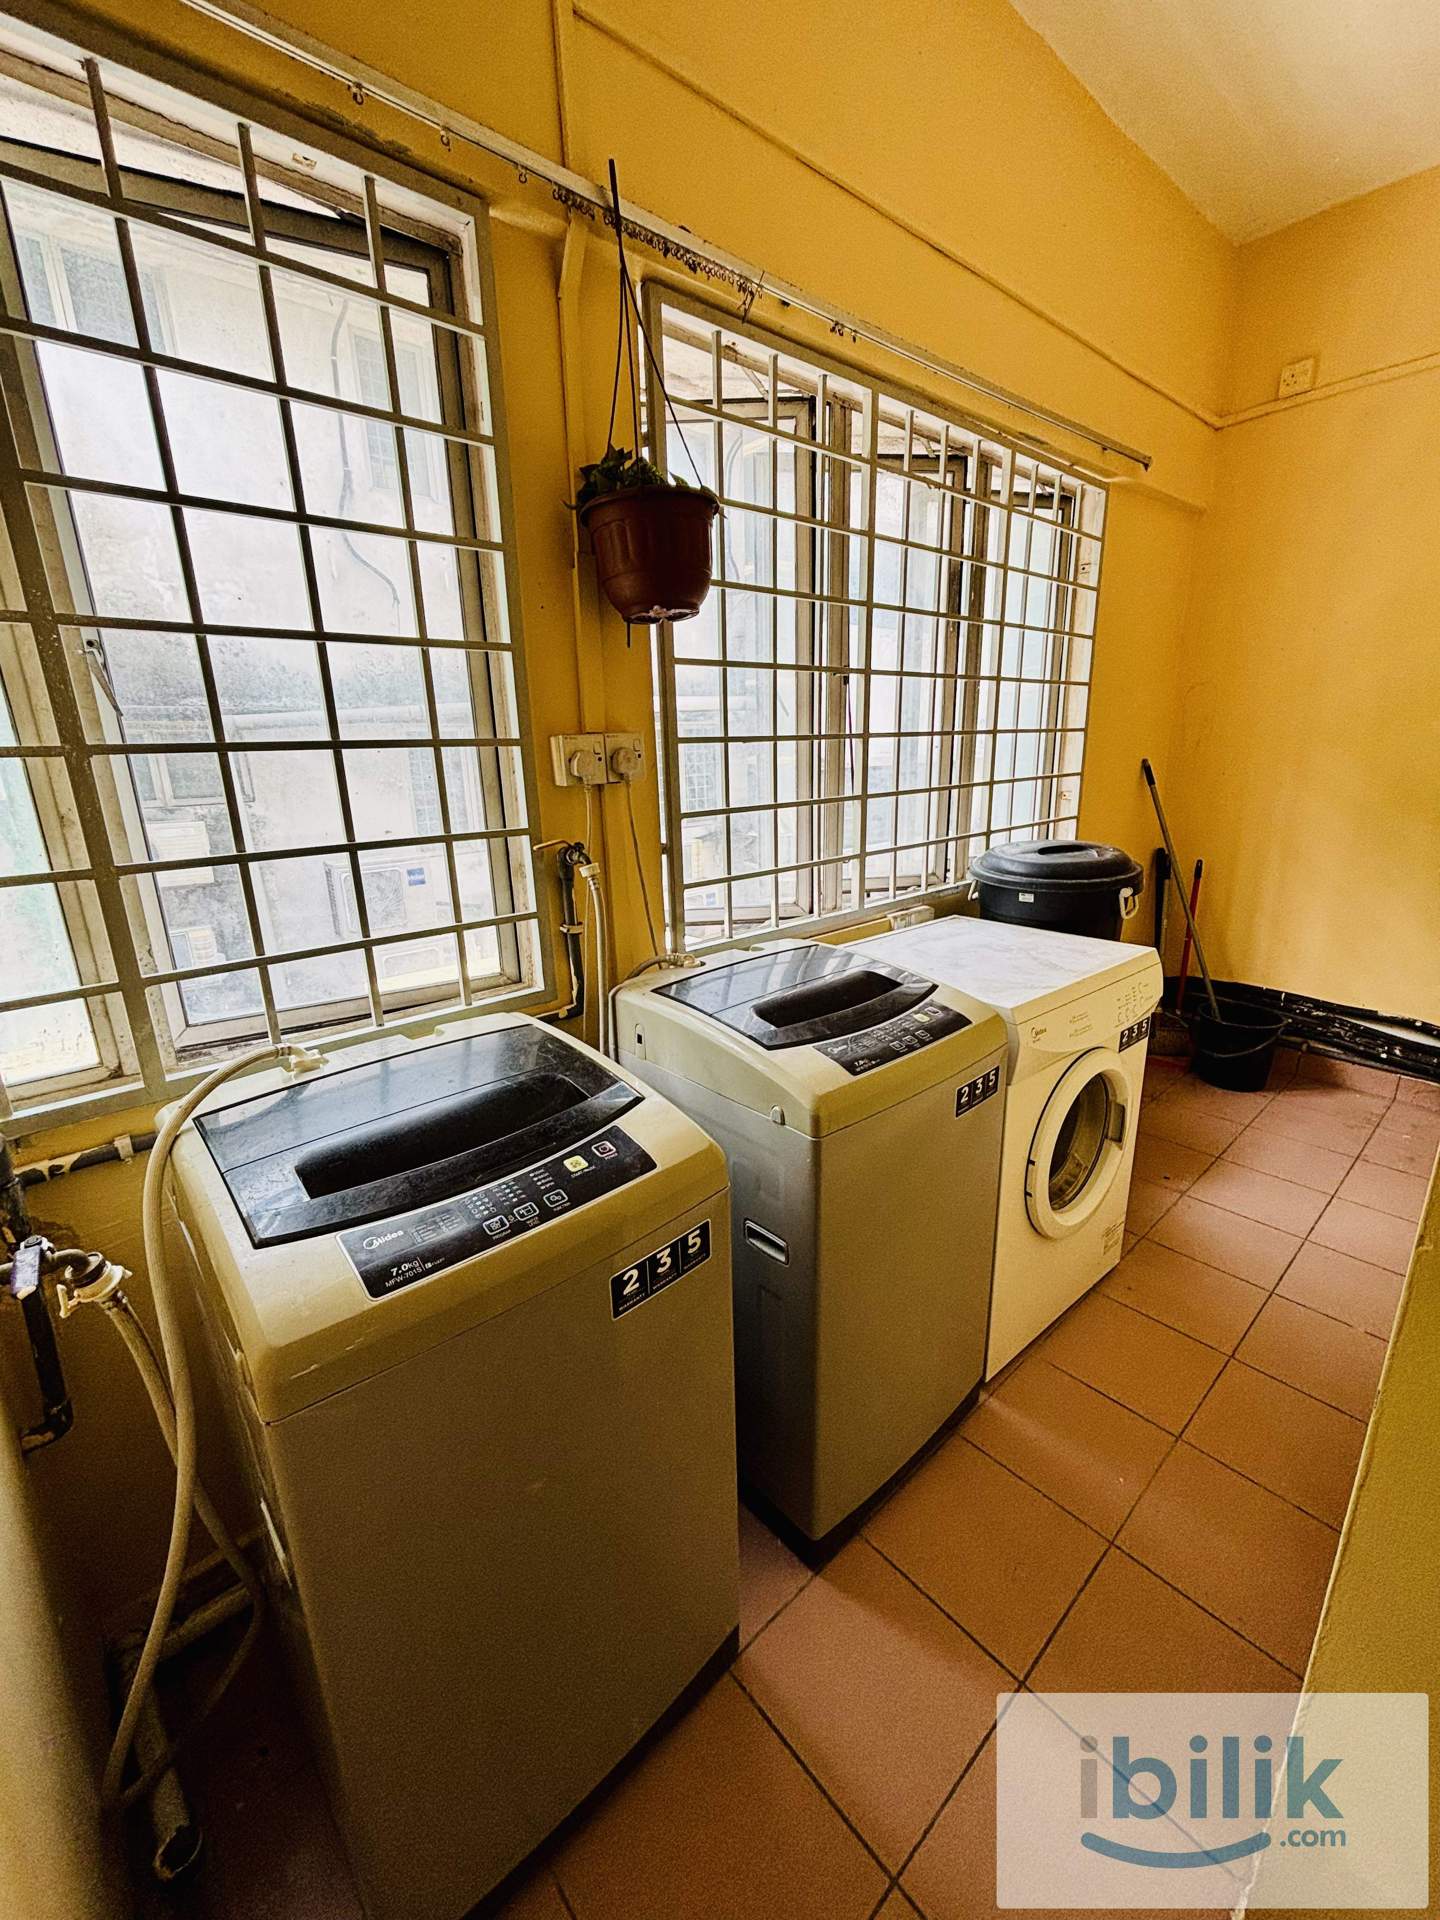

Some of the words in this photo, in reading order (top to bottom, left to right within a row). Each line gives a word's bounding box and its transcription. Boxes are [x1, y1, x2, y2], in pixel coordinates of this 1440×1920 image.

[1122, 1030, 1129, 1043] 2
[1132, 1024, 1139, 1037] 3
[1142, 1019, 1148, 1031] 5
[960, 1086, 969, 1103] 2
[975, 1077, 984, 1094] 3
[988, 1070, 996, 1086] 5
[363, 1230, 404, 1250] Midea
[390, 1260, 420, 1277] 7.0kg
[622, 1268, 640, 1296] 2
[656, 1247, 672, 1273] 3
[687, 1229, 702, 1254] 5
[385, 1266, 423, 1288] MFW-701S
